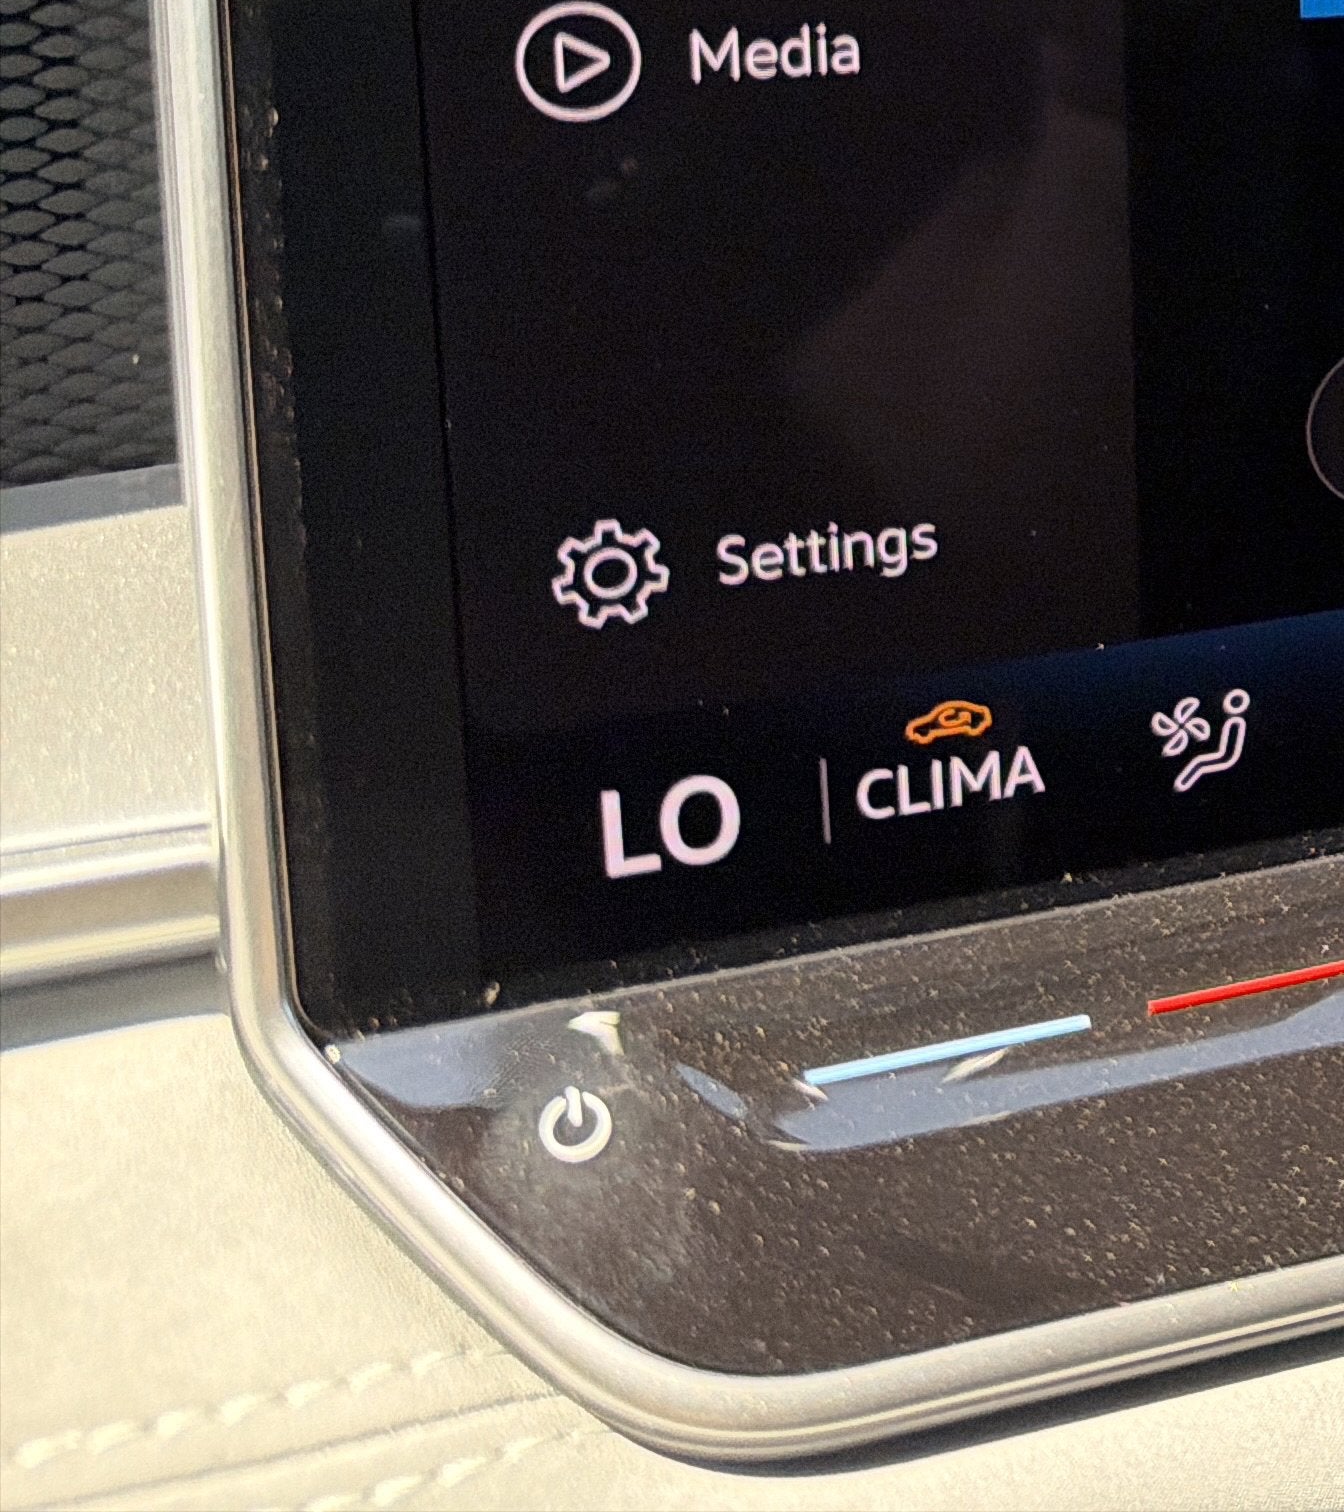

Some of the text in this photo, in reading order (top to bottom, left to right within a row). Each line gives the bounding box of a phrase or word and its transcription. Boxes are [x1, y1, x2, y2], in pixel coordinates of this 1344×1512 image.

[689, 22, 861, 85] Media
[716, 520, 939, 587] Settings
[855, 745, 1047, 821] CLIMA
[600, 774, 742, 879] LO
